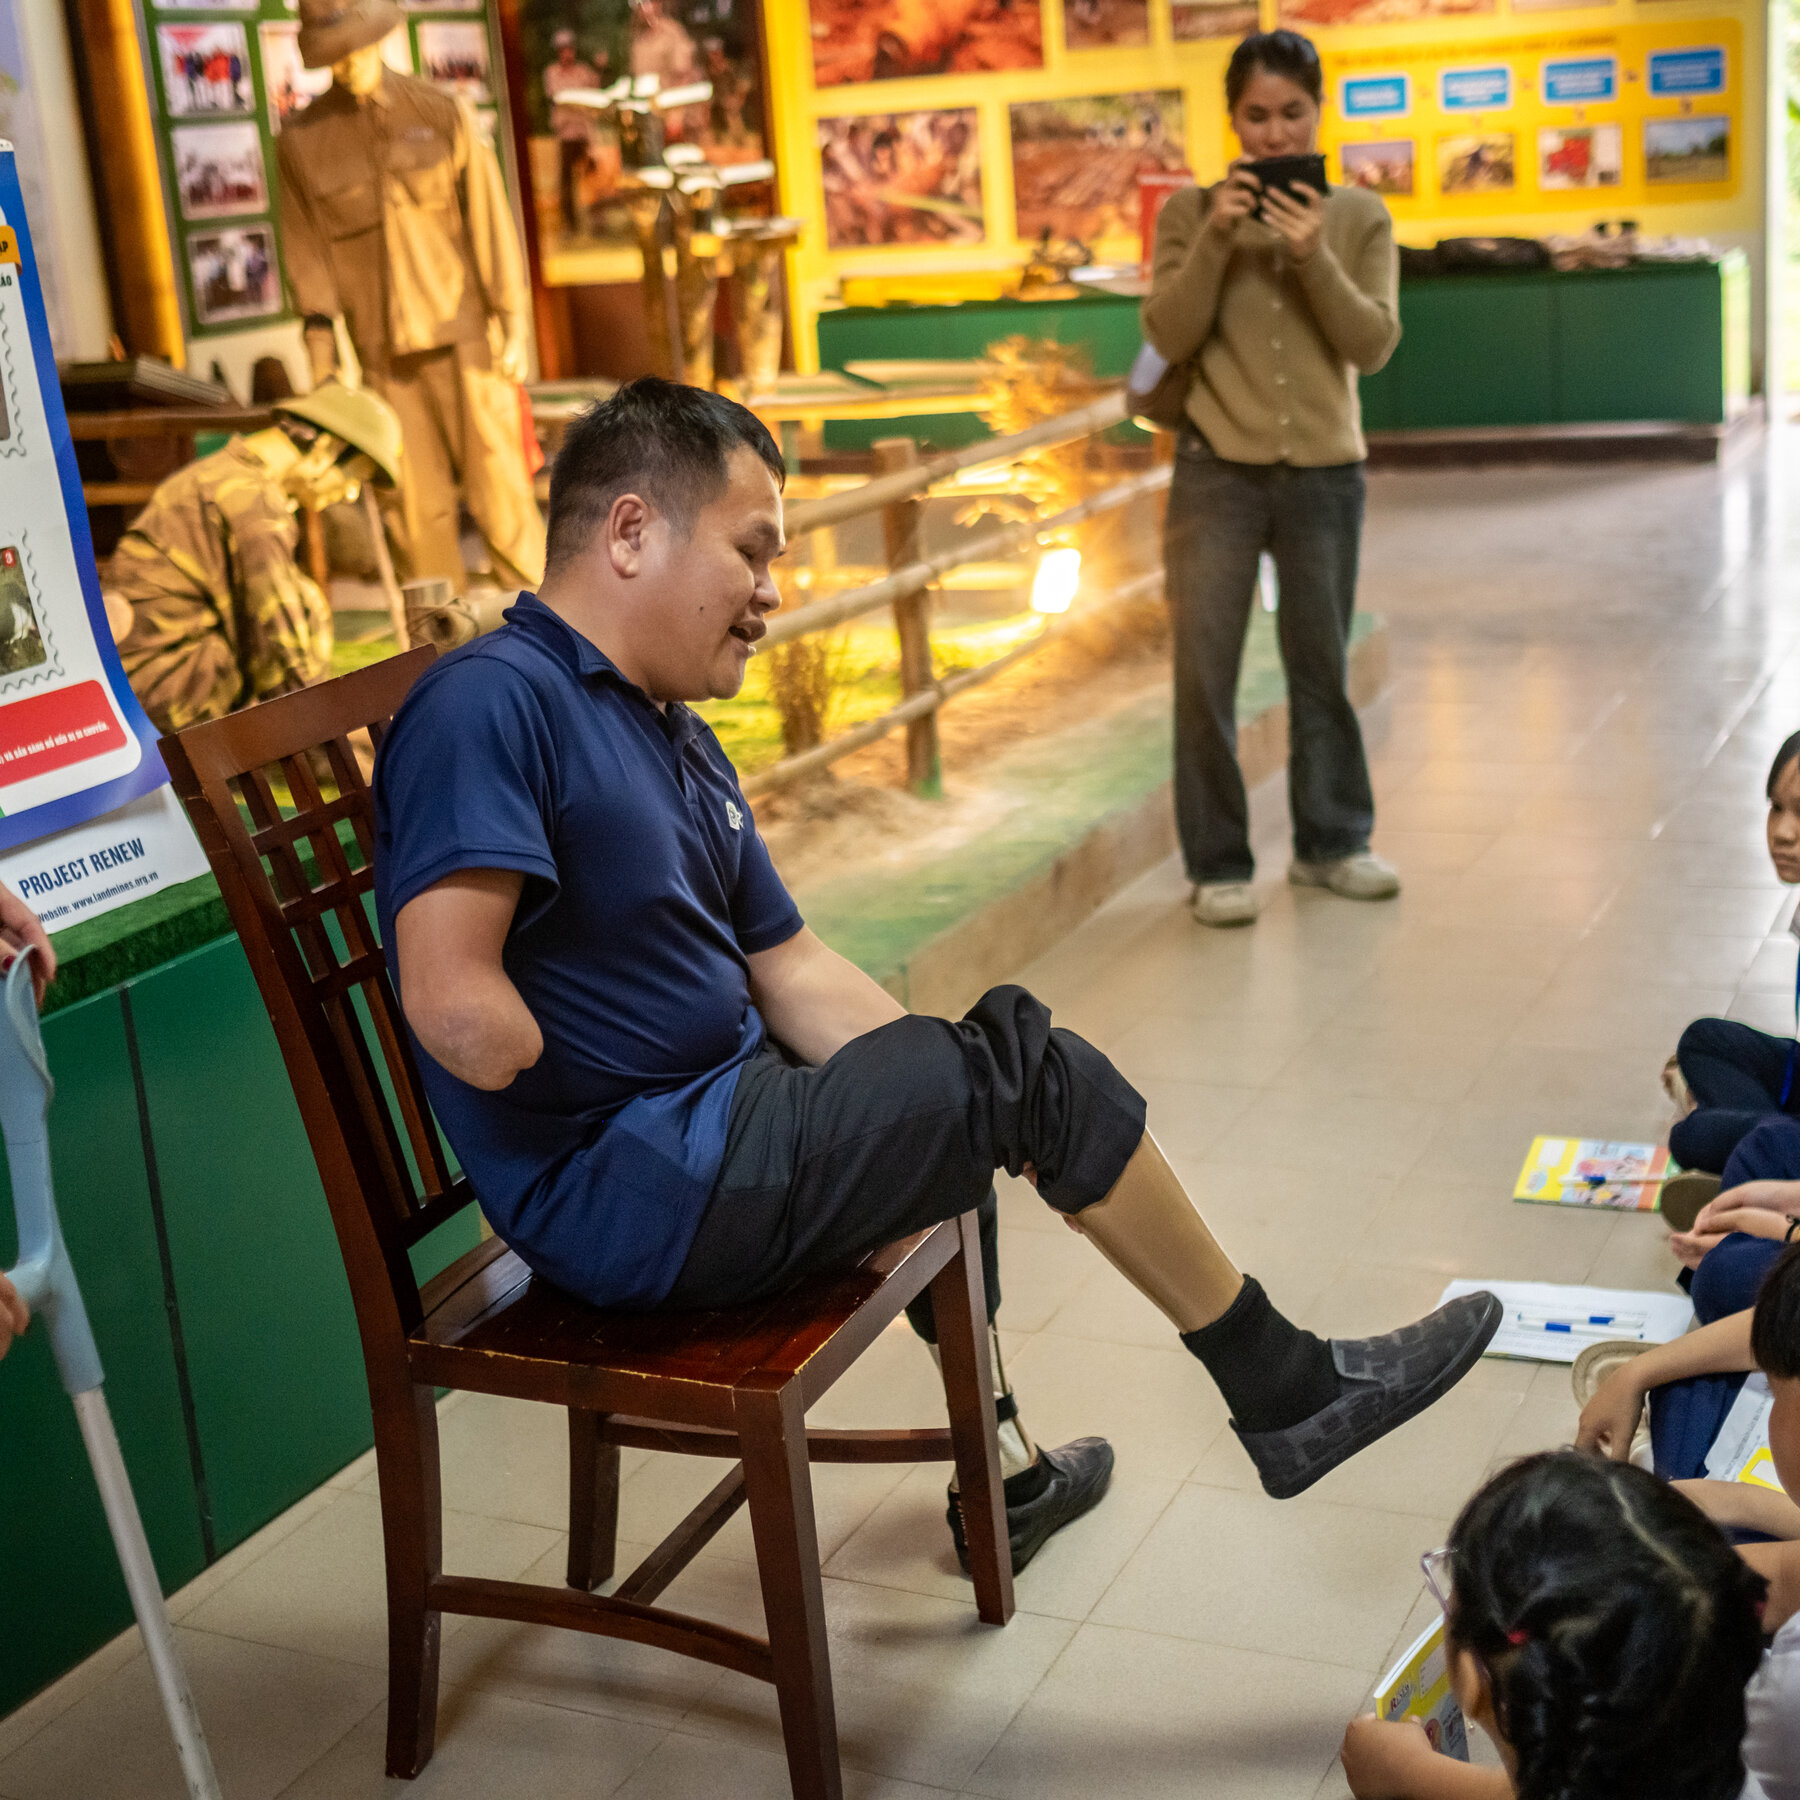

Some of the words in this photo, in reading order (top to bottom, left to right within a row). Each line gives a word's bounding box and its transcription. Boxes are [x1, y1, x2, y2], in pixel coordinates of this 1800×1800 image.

[18, 858, 90, 899] PROJECT
[89, 837, 145, 873] RENEW
[72, 871, 159, 911] www.landmines.org.vn
